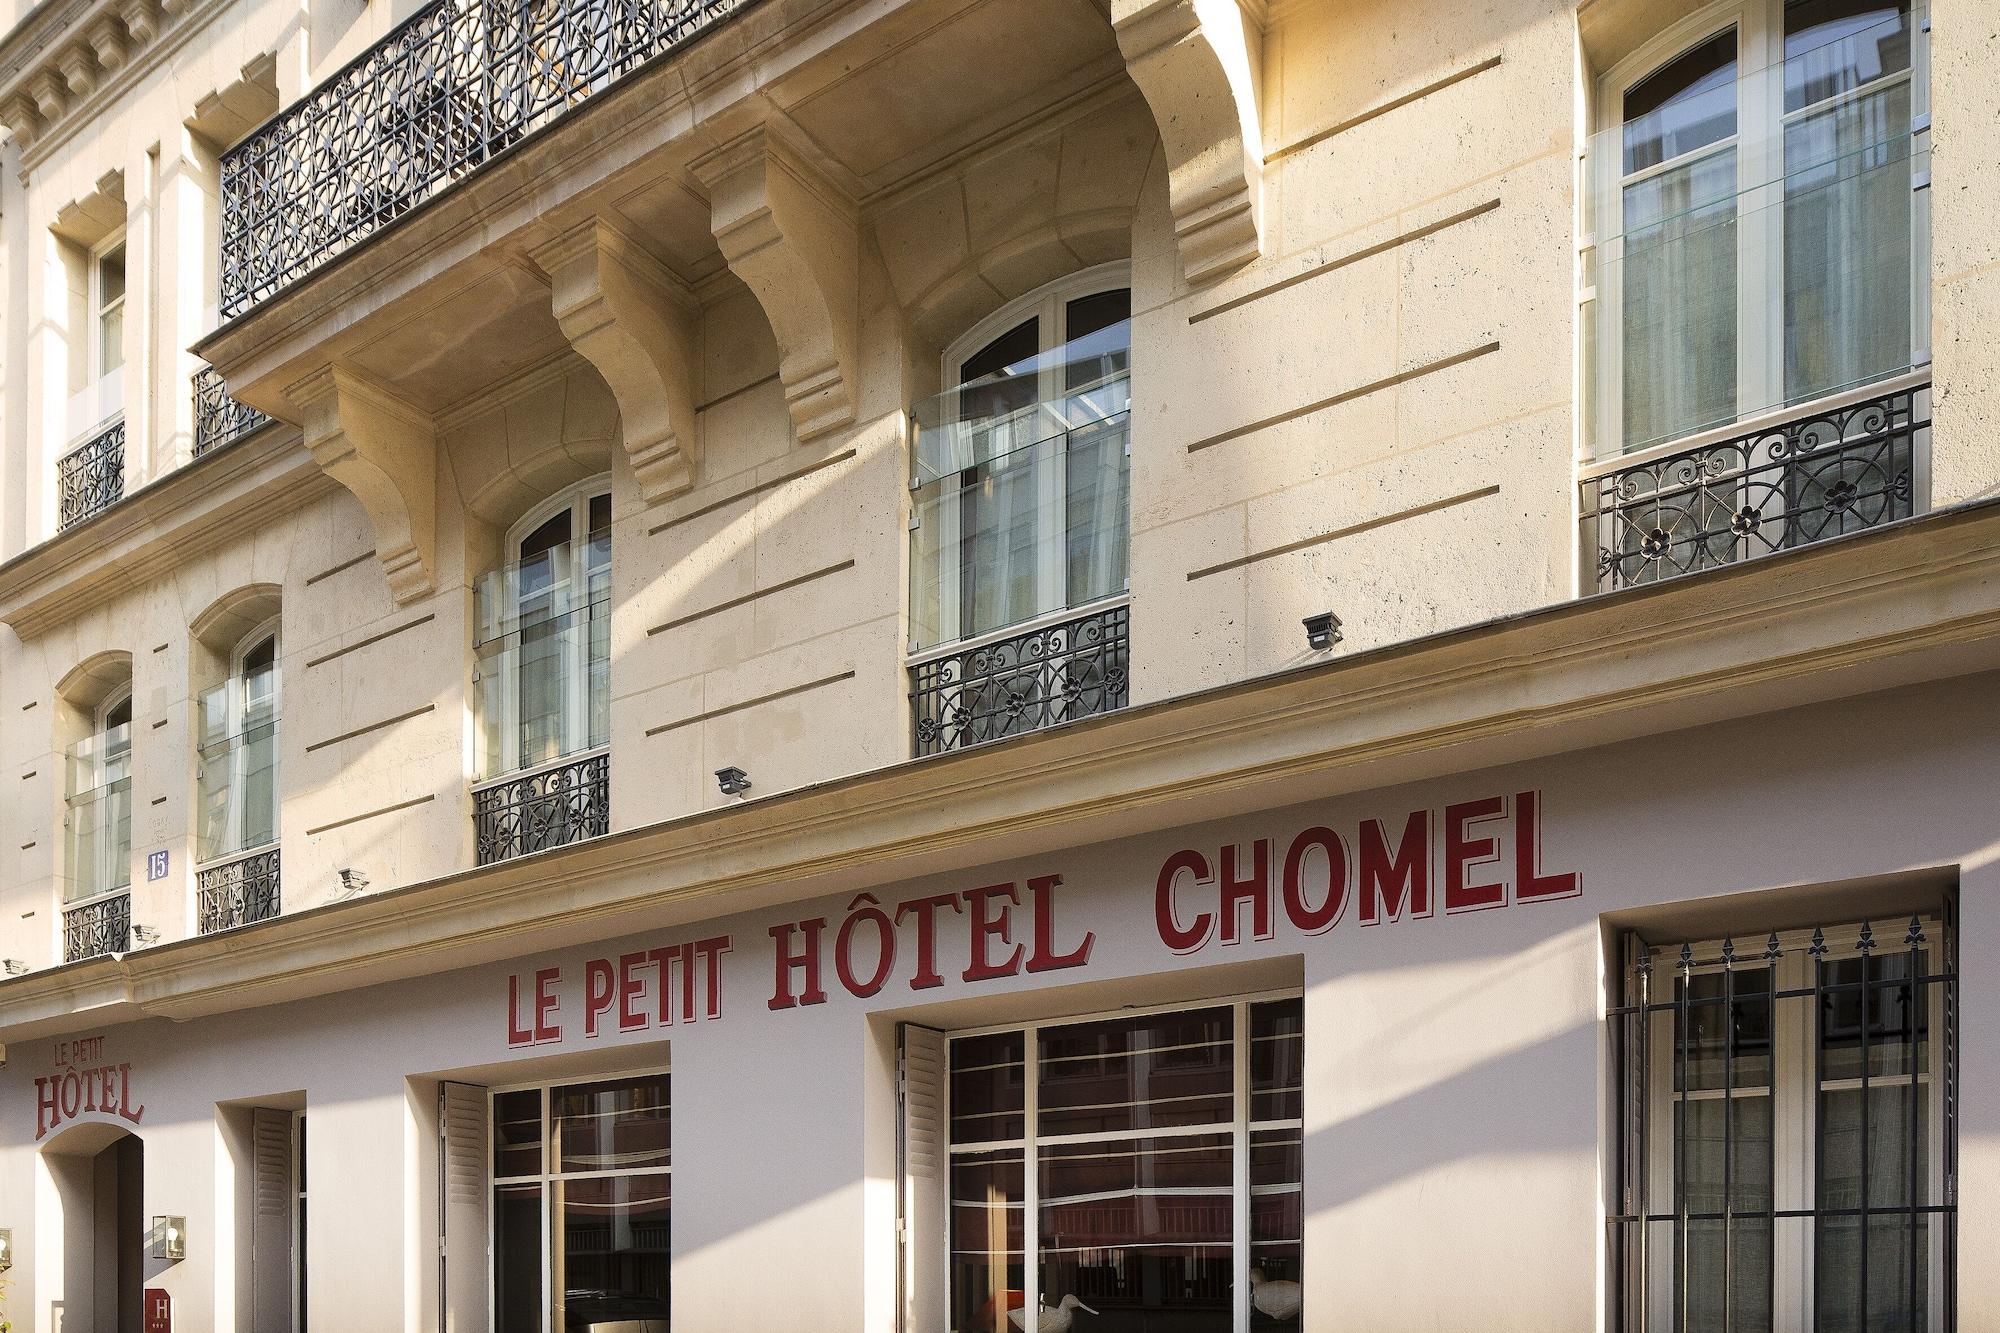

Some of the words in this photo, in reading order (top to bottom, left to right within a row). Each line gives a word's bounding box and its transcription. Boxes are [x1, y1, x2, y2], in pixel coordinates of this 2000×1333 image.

[151, 852, 166, 879] 15
[507, 967, 562, 1049] LE
[585, 934, 733, 1039] PETIT
[767, 873, 1096, 1011] HÔTEL
[1155, 789, 1583, 956] CHOMEL
[54, 1043, 68, 1067] LE
[72, 1036, 105, 1063] PETIT
[35, 1063, 145, 1141] HÔTEL
[156, 1299, 169, 1319] H
